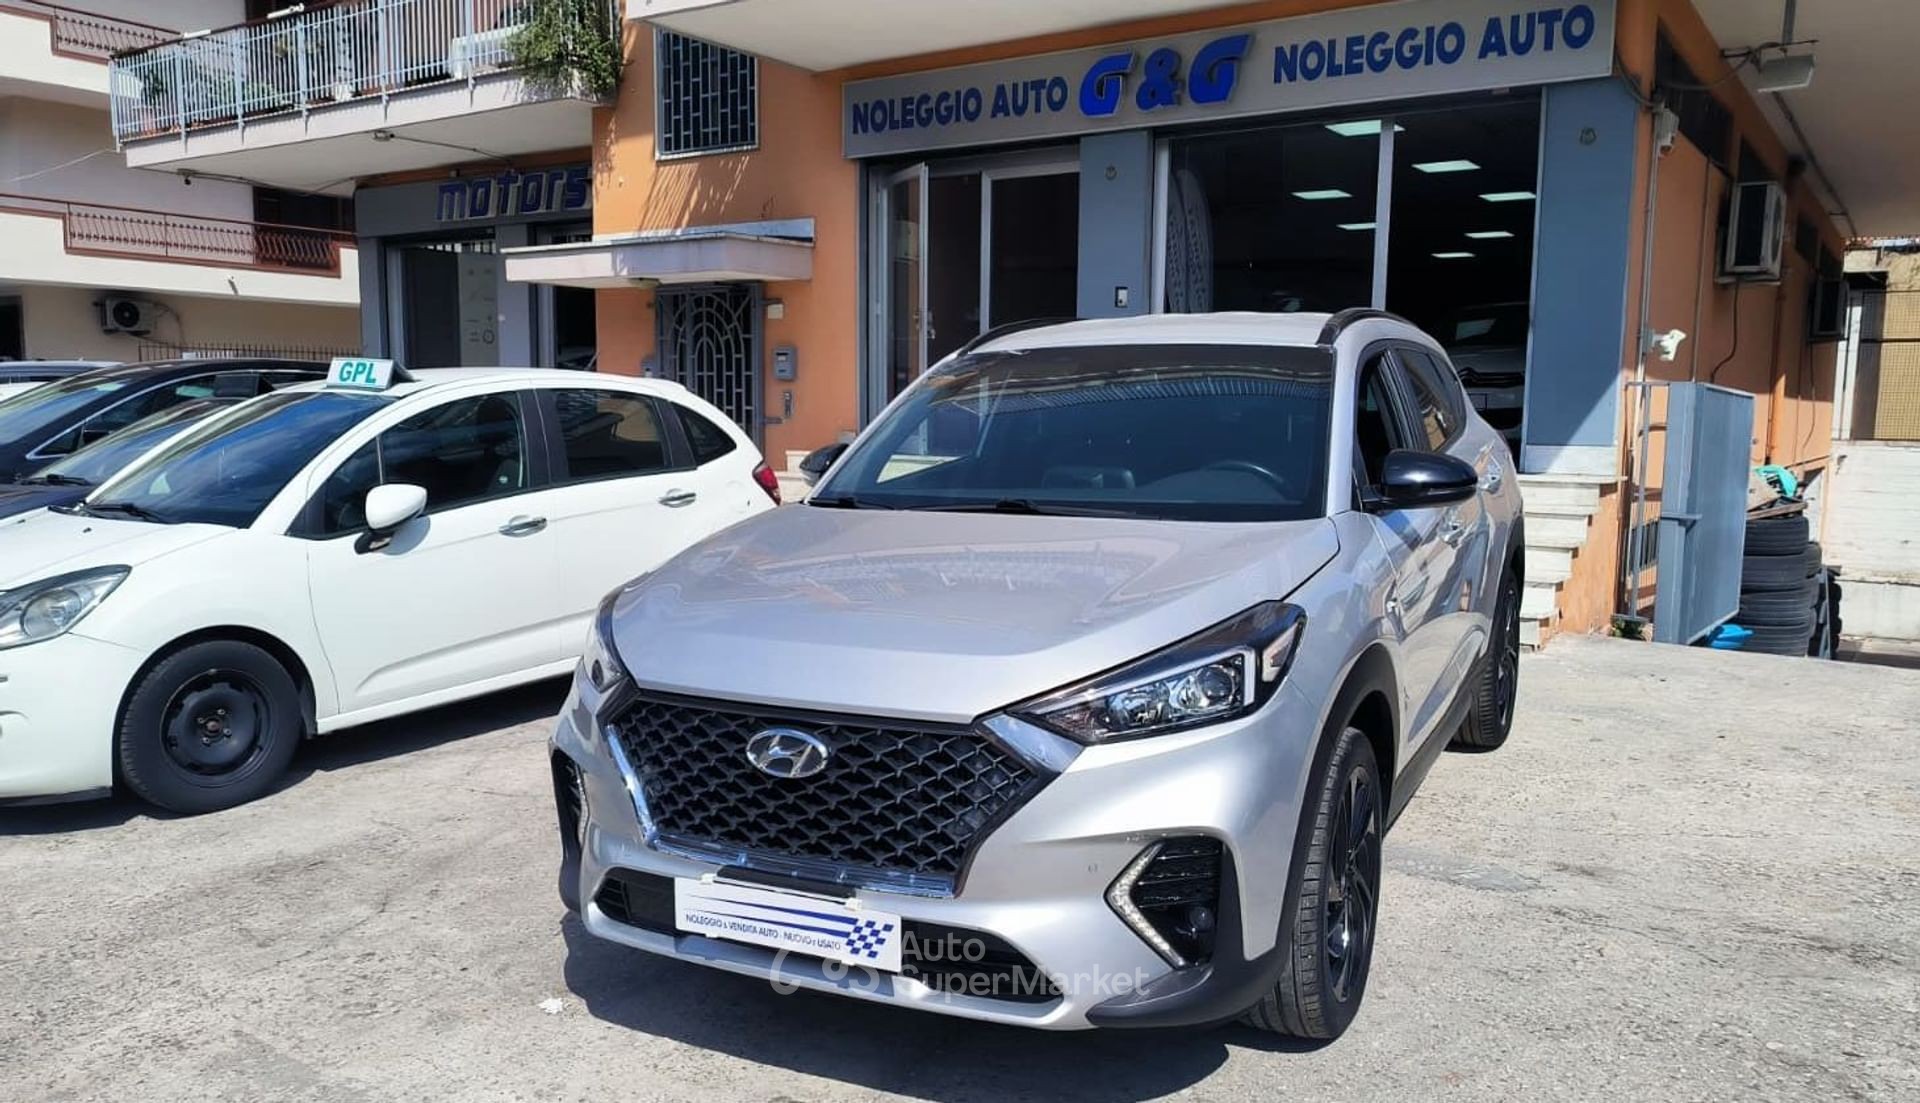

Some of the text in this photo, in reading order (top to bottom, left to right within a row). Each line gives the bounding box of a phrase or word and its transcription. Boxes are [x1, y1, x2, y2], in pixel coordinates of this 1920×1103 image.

[852, 86, 982, 135] NOLEGGIO
[990, 76, 1068, 119] AUTO
[1273, 21, 1466, 84] NOLEGGIO
[1478, 4, 1596, 60] AUTO
[338, 361, 377, 384] GPL
[685, 913, 723, 929] NOLEGGIO
[728, 919, 758, 934] VENDITA
[758, 926, 779, 939] AUTO
[783, 931, 812, 945] NUOVO
[817, 938, 841, 950] USATO
